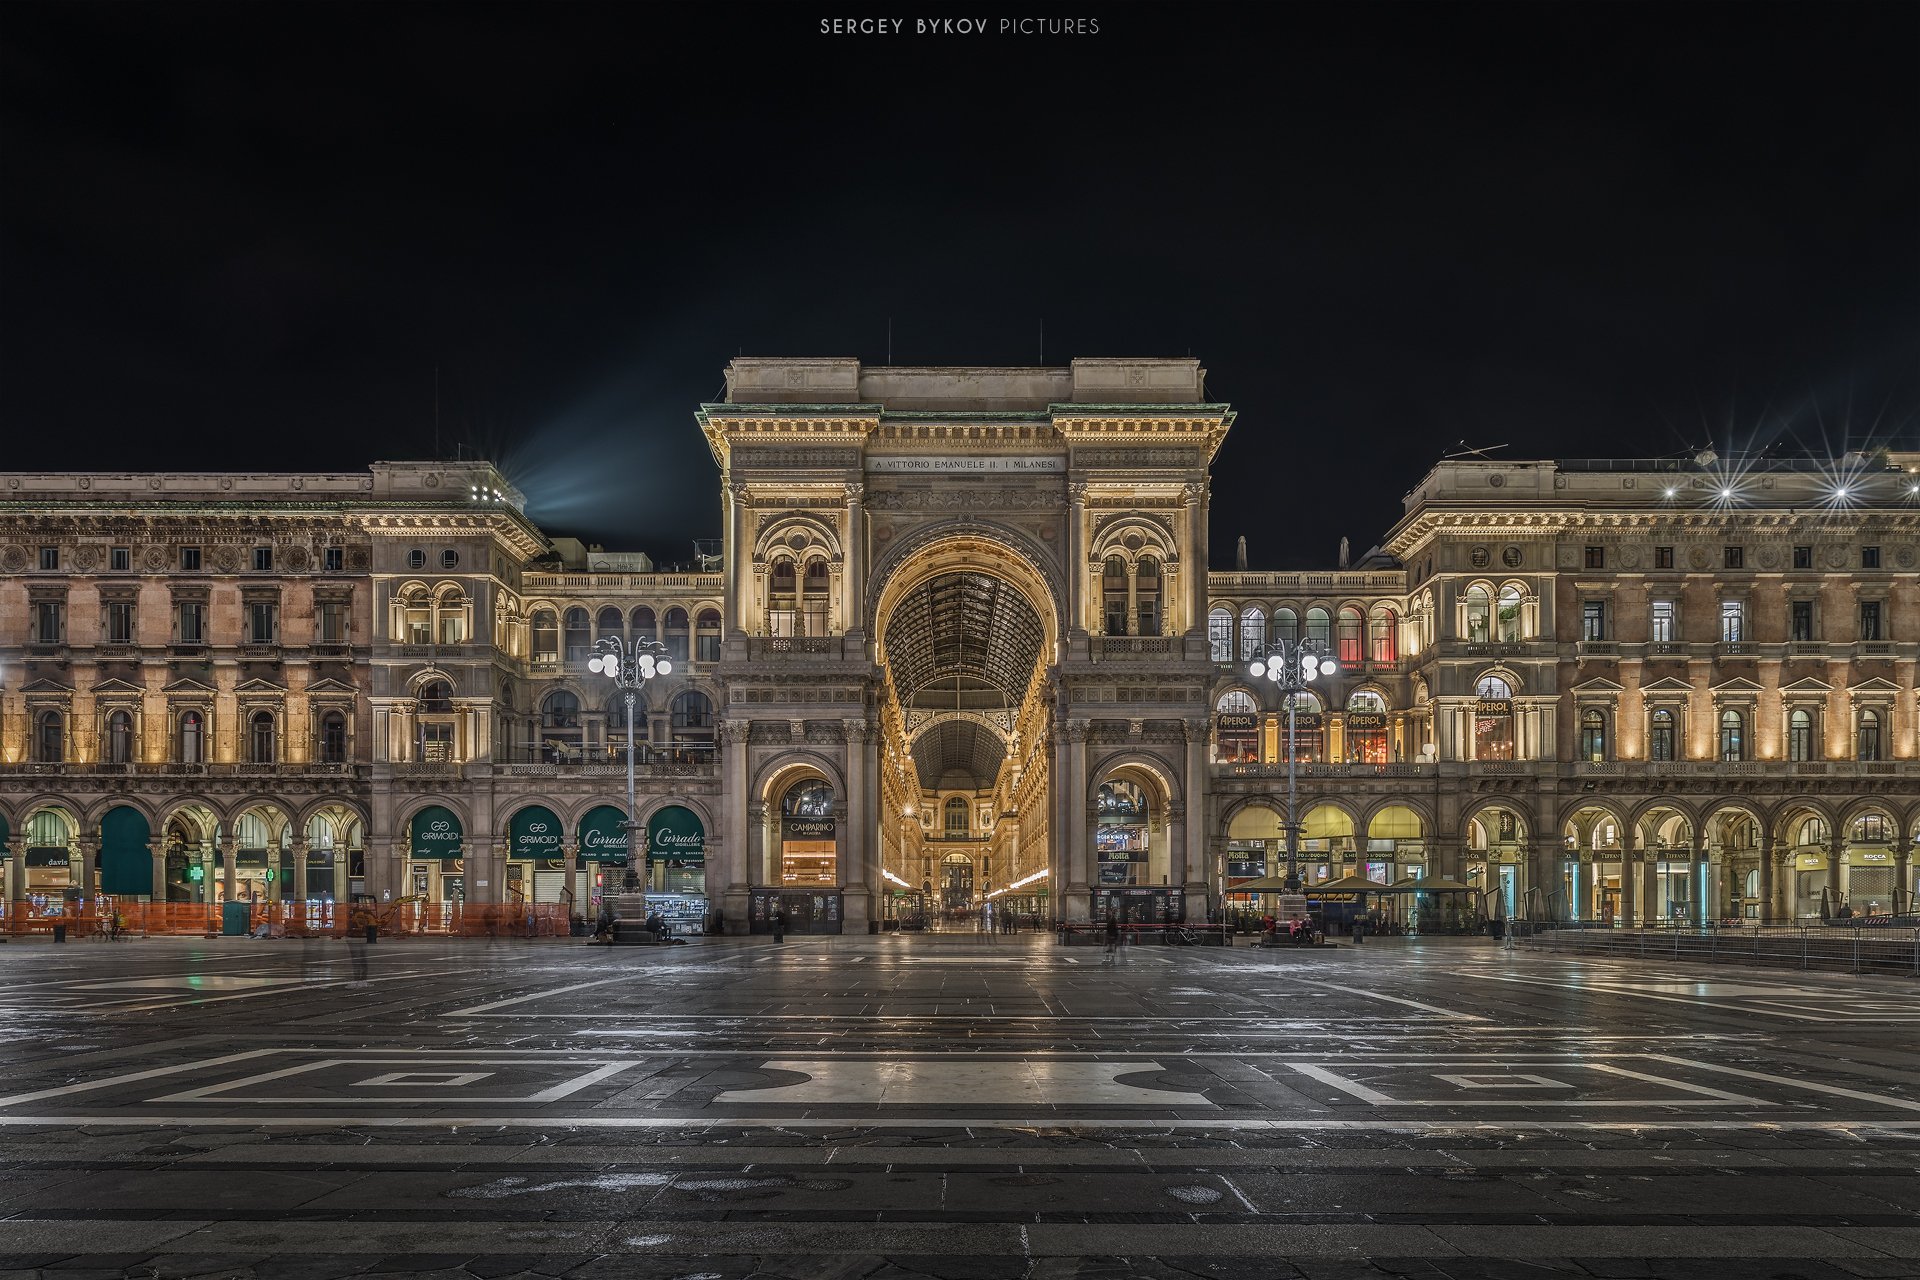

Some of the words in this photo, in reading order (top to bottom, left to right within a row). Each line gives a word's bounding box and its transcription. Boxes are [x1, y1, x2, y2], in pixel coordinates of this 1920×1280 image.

[875, 461, 882, 469] A
[887, 461, 930, 469] VITTORIO
[934, 461, 985, 469] EMANUELE
[1013, 461, 1056, 469] MILANESI
[1476, 701, 1509, 711] APEROL
[1220, 715, 1253, 725] APEROL
[1284, 714, 1316, 725] AEROL
[1349, 714, 1381, 725] APEROL
[790, 823, 834, 832] CAMPARINO
[421, 832, 459, 840] GRIMOLDI
[519, 835, 558, 844] GRIMOLDI
[655, 827, 701, 847] Currado
[1107, 852, 1130, 860] Motta
[1228, 851, 1250, 859] Motta
[48, 858, 68, 866] davis
